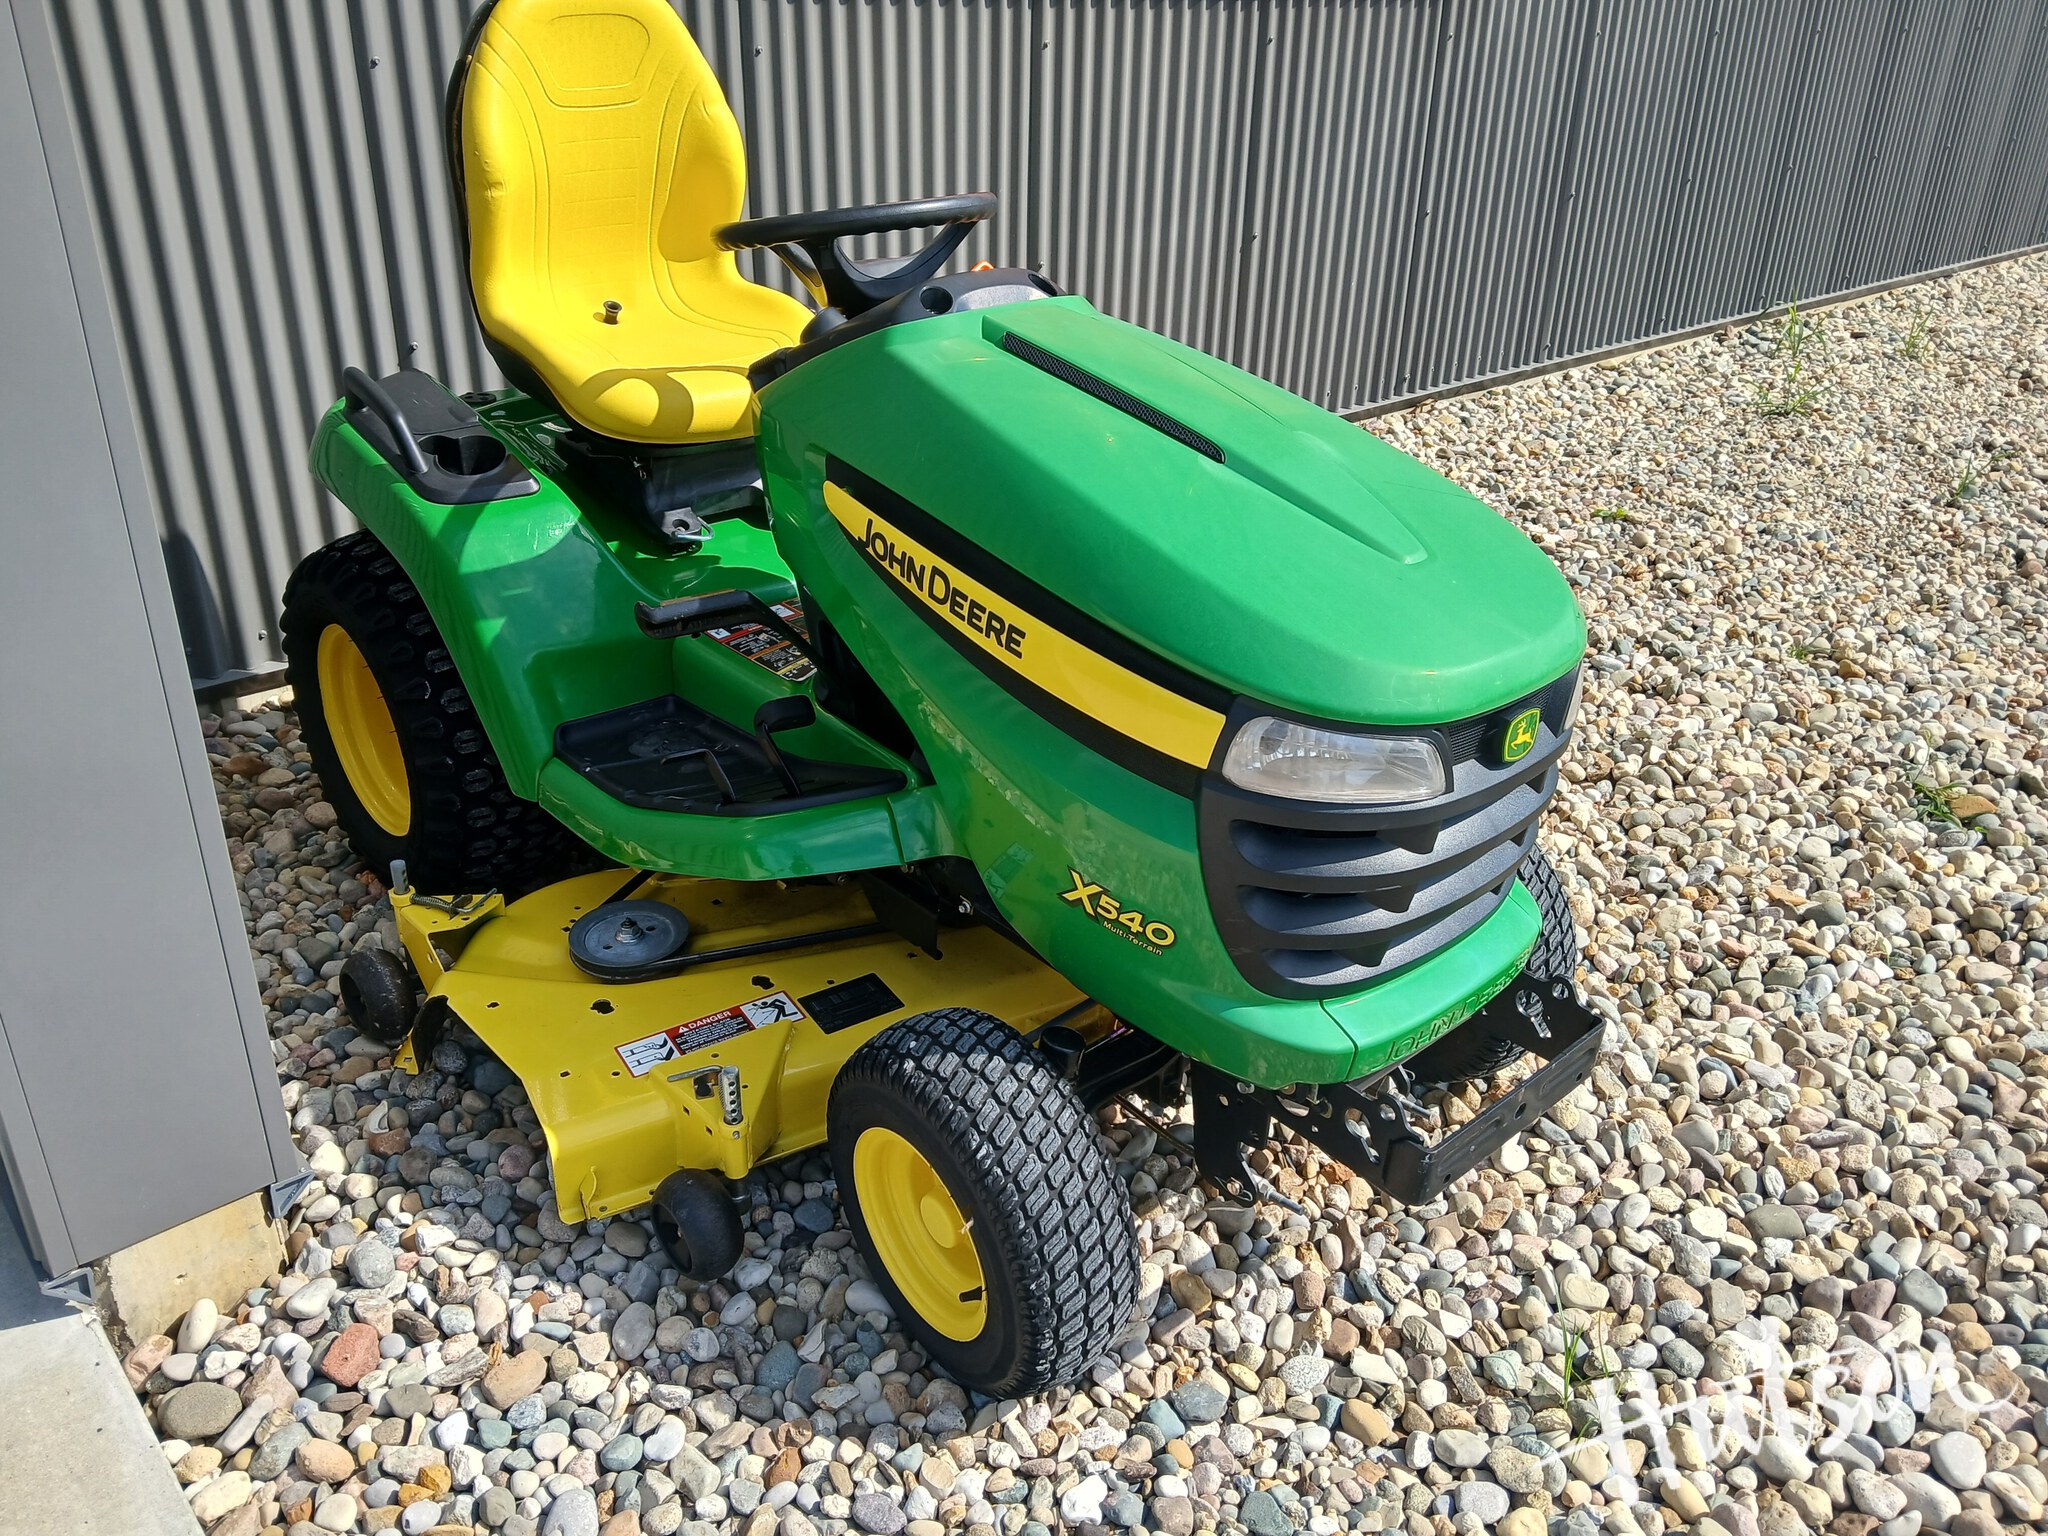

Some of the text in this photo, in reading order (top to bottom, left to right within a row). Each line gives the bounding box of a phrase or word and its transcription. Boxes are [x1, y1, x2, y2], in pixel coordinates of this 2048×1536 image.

[857, 518, 1027, 660] JOHN DEERE
[1060, 866, 1176, 947] X540
[1102, 920, 1163, 956] Multi-Terrain
[688, 1011, 732, 1029] DANGER
[1375, 1010, 1457, 1065] JOHN
